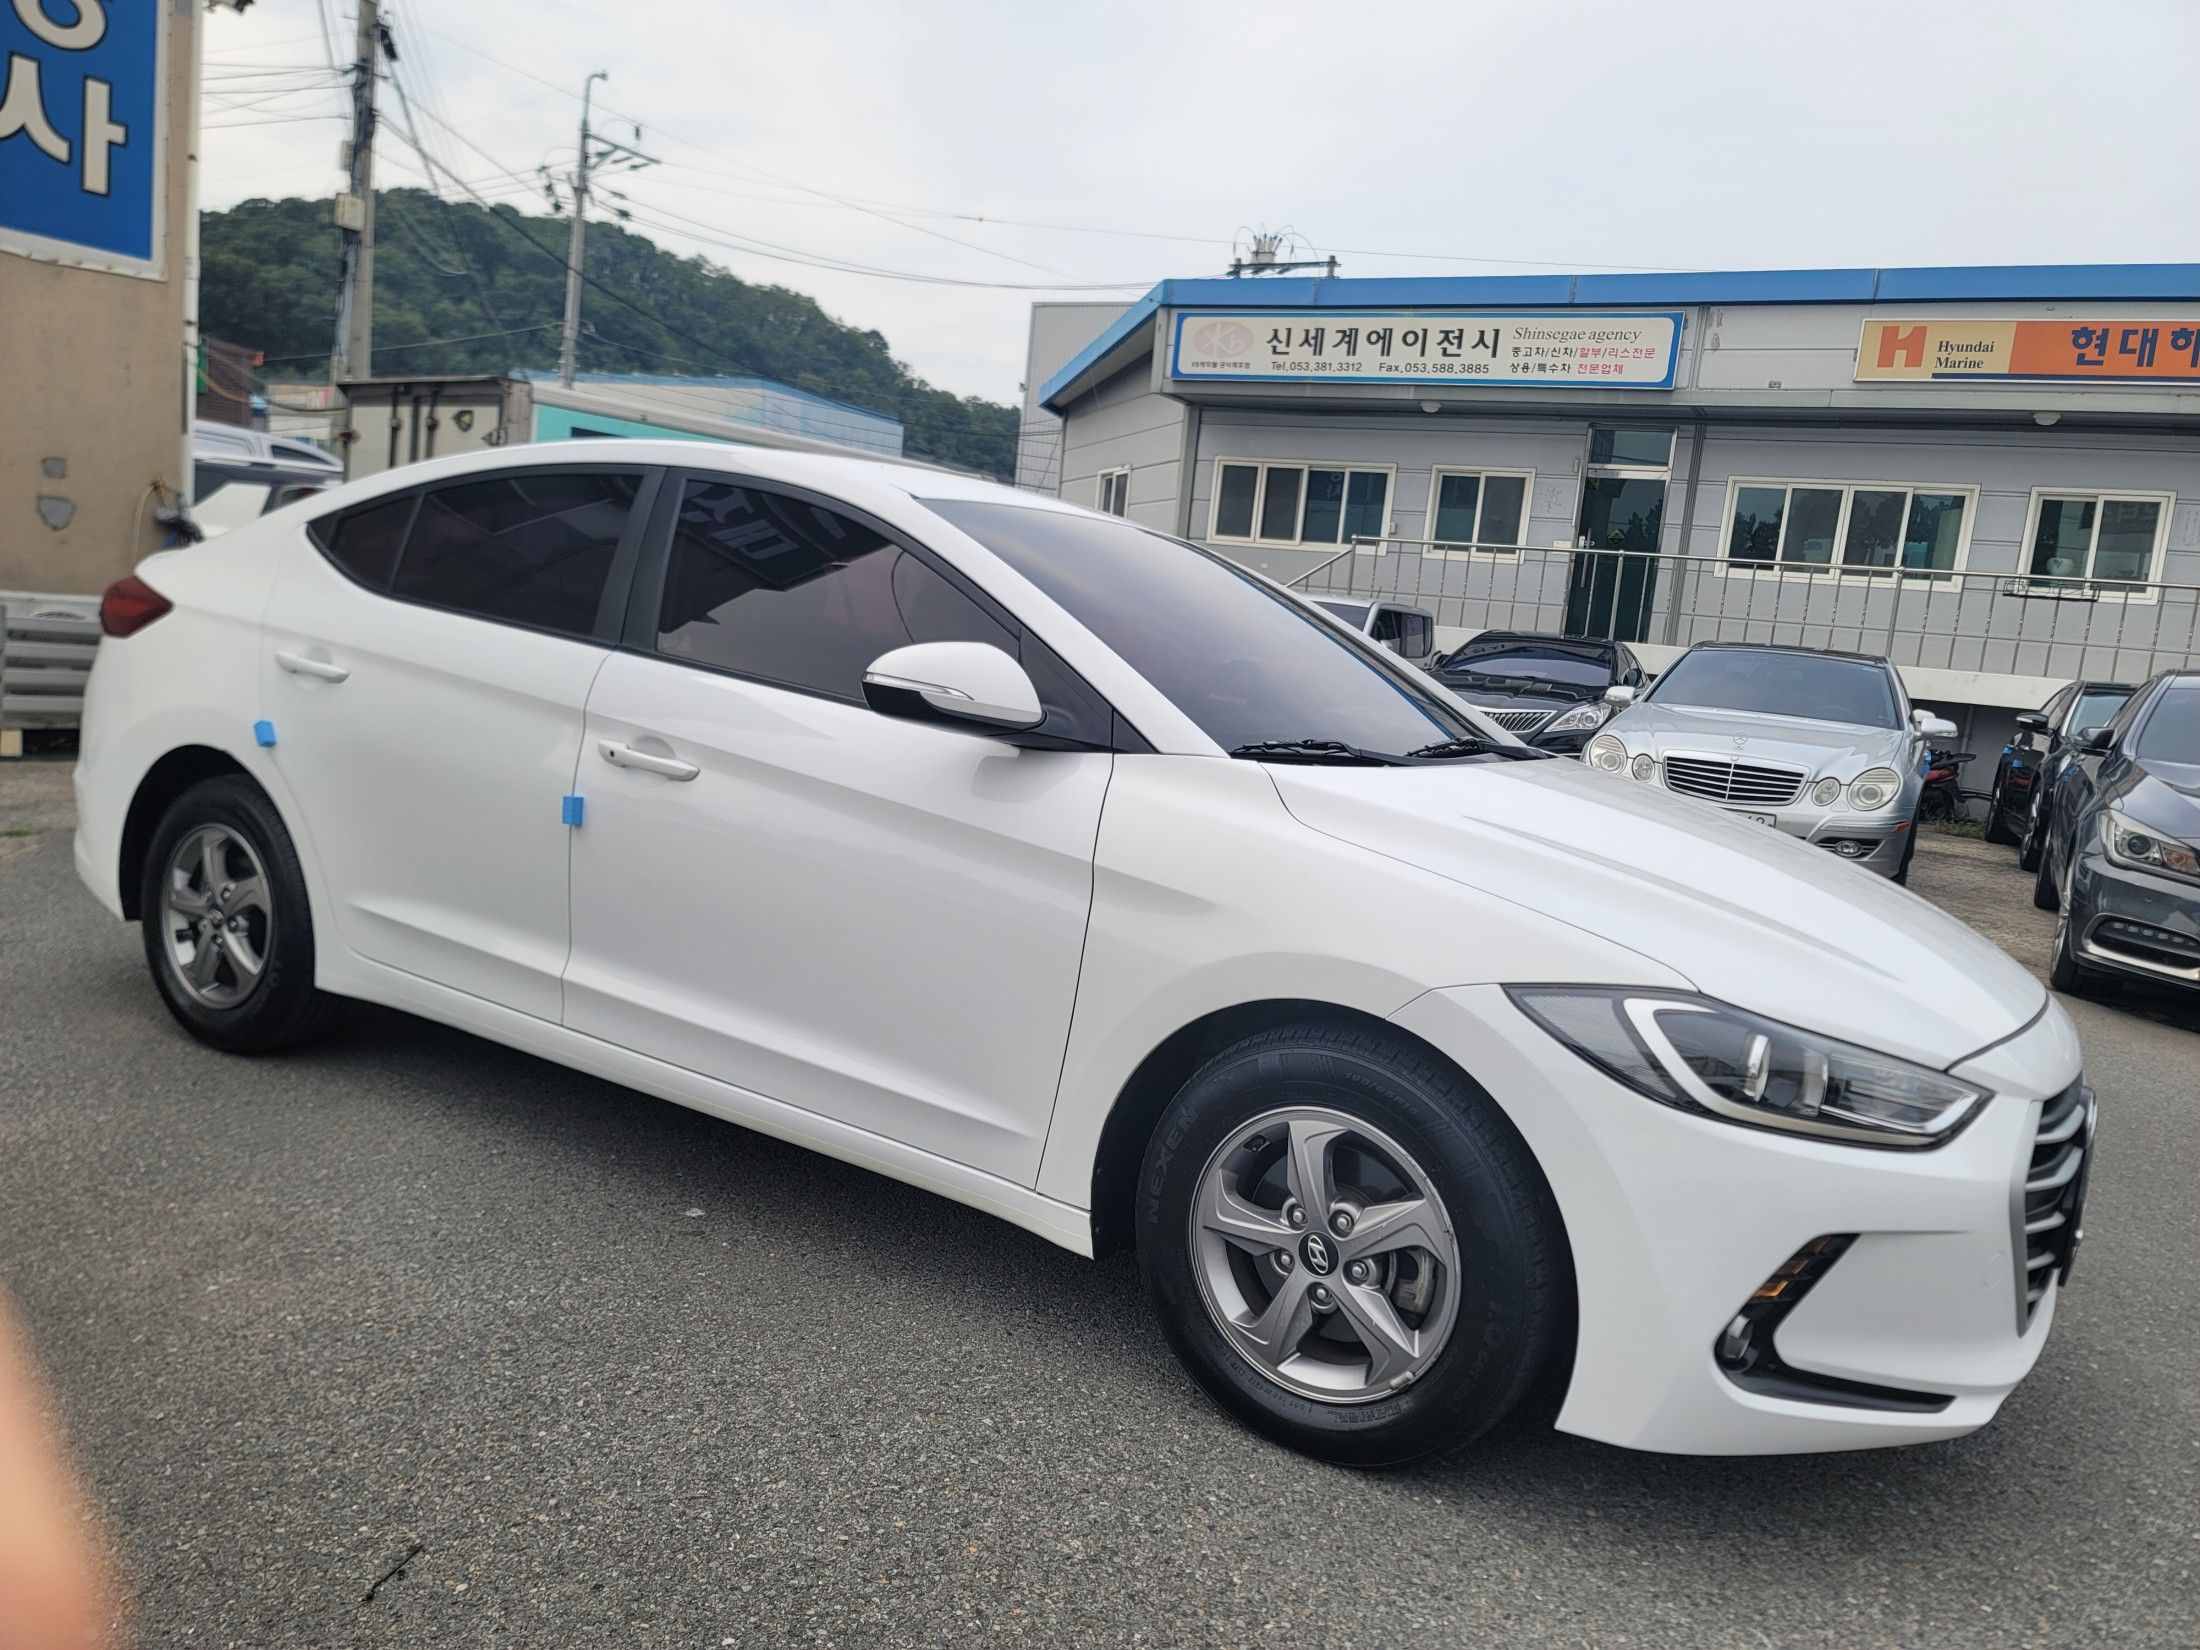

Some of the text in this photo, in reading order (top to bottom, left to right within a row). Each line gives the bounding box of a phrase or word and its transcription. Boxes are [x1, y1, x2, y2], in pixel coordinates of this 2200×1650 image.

[1266, 327, 1500, 358] 신세계에이전시
[1513, 327, 1642, 344] Shinsegae agency
[1937, 340, 1995, 355] Hyundai
[1934, 356, 1984, 369] Marine
[1148, 1102, 1200, 1225] NEXEN
